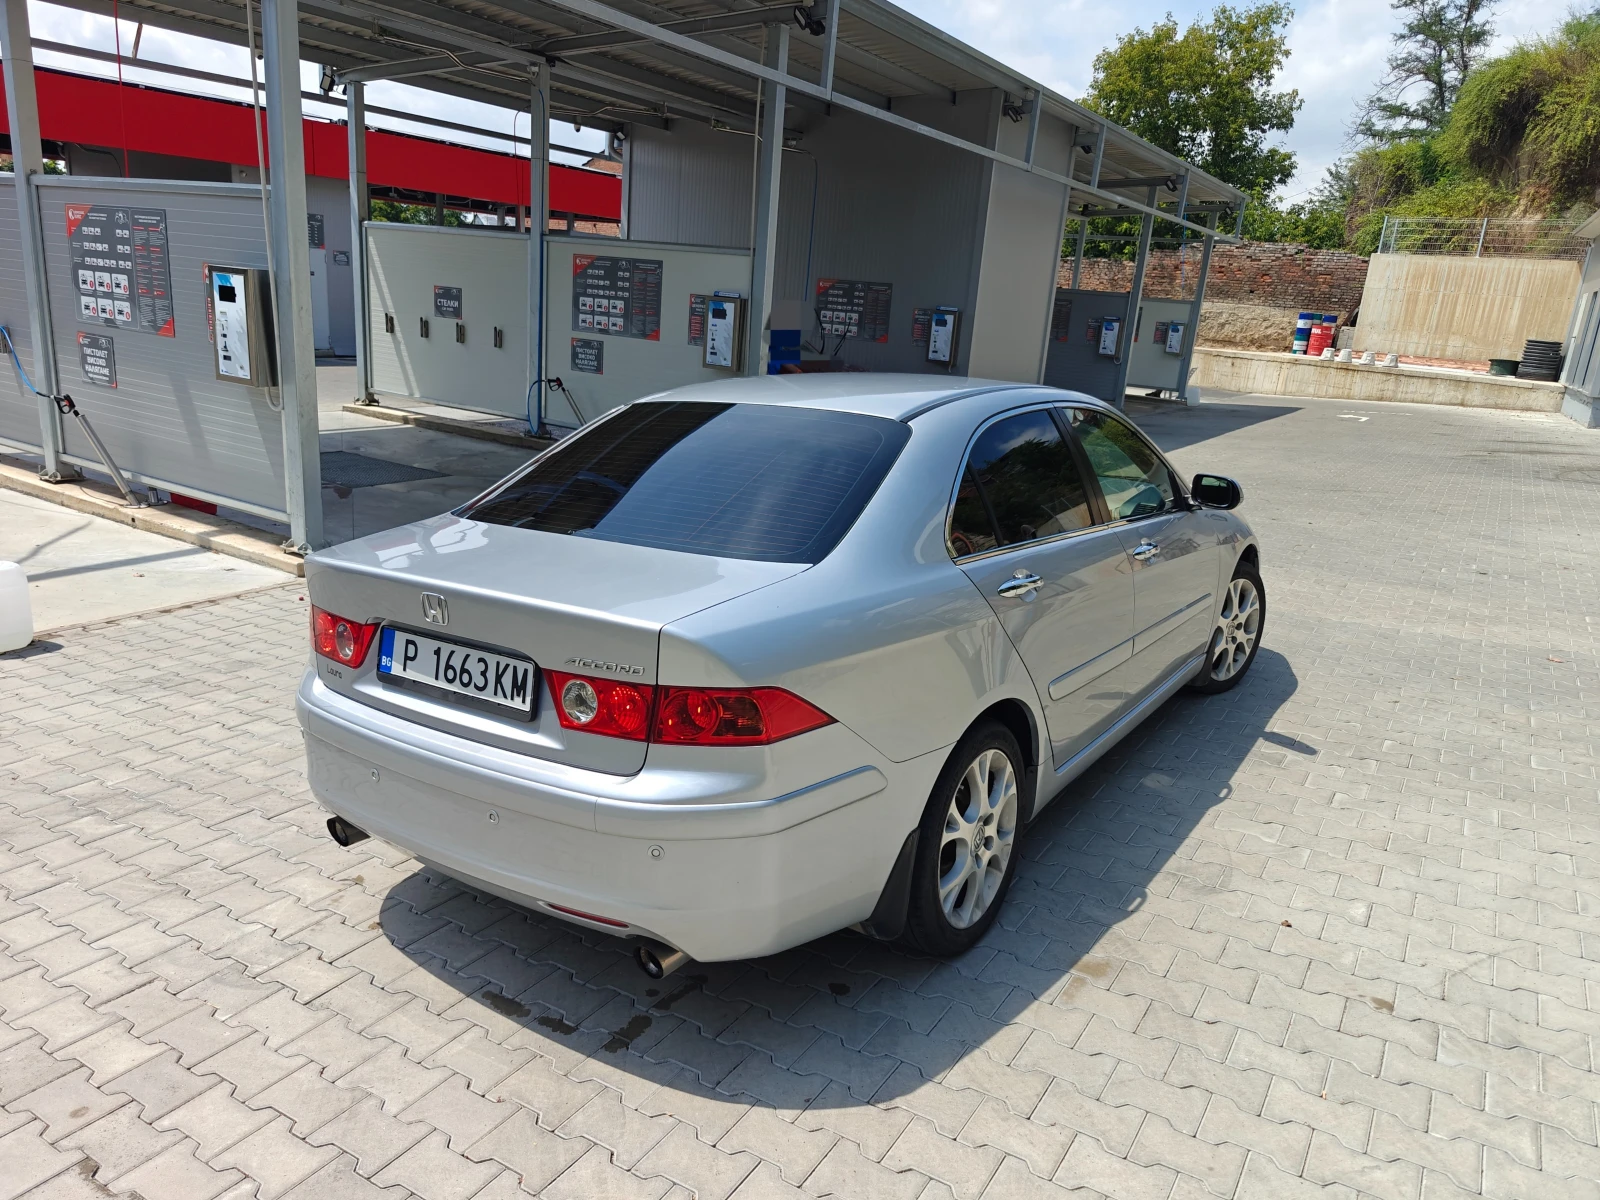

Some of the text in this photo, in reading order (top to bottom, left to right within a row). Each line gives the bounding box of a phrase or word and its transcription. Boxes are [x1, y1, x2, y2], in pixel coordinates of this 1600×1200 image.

[437, 299, 459, 308] СТЕЛКИ
[84, 347, 108, 358] ПИСТОЛЕТ
[87, 356, 106, 366] ВИСОКО
[85, 364, 110, 376] НАЛЯГАНЕ
[381, 655, 392, 667] BG
[564, 657, 646, 676] ACCORD
[402, 639, 529, 704] P 1663 KM
